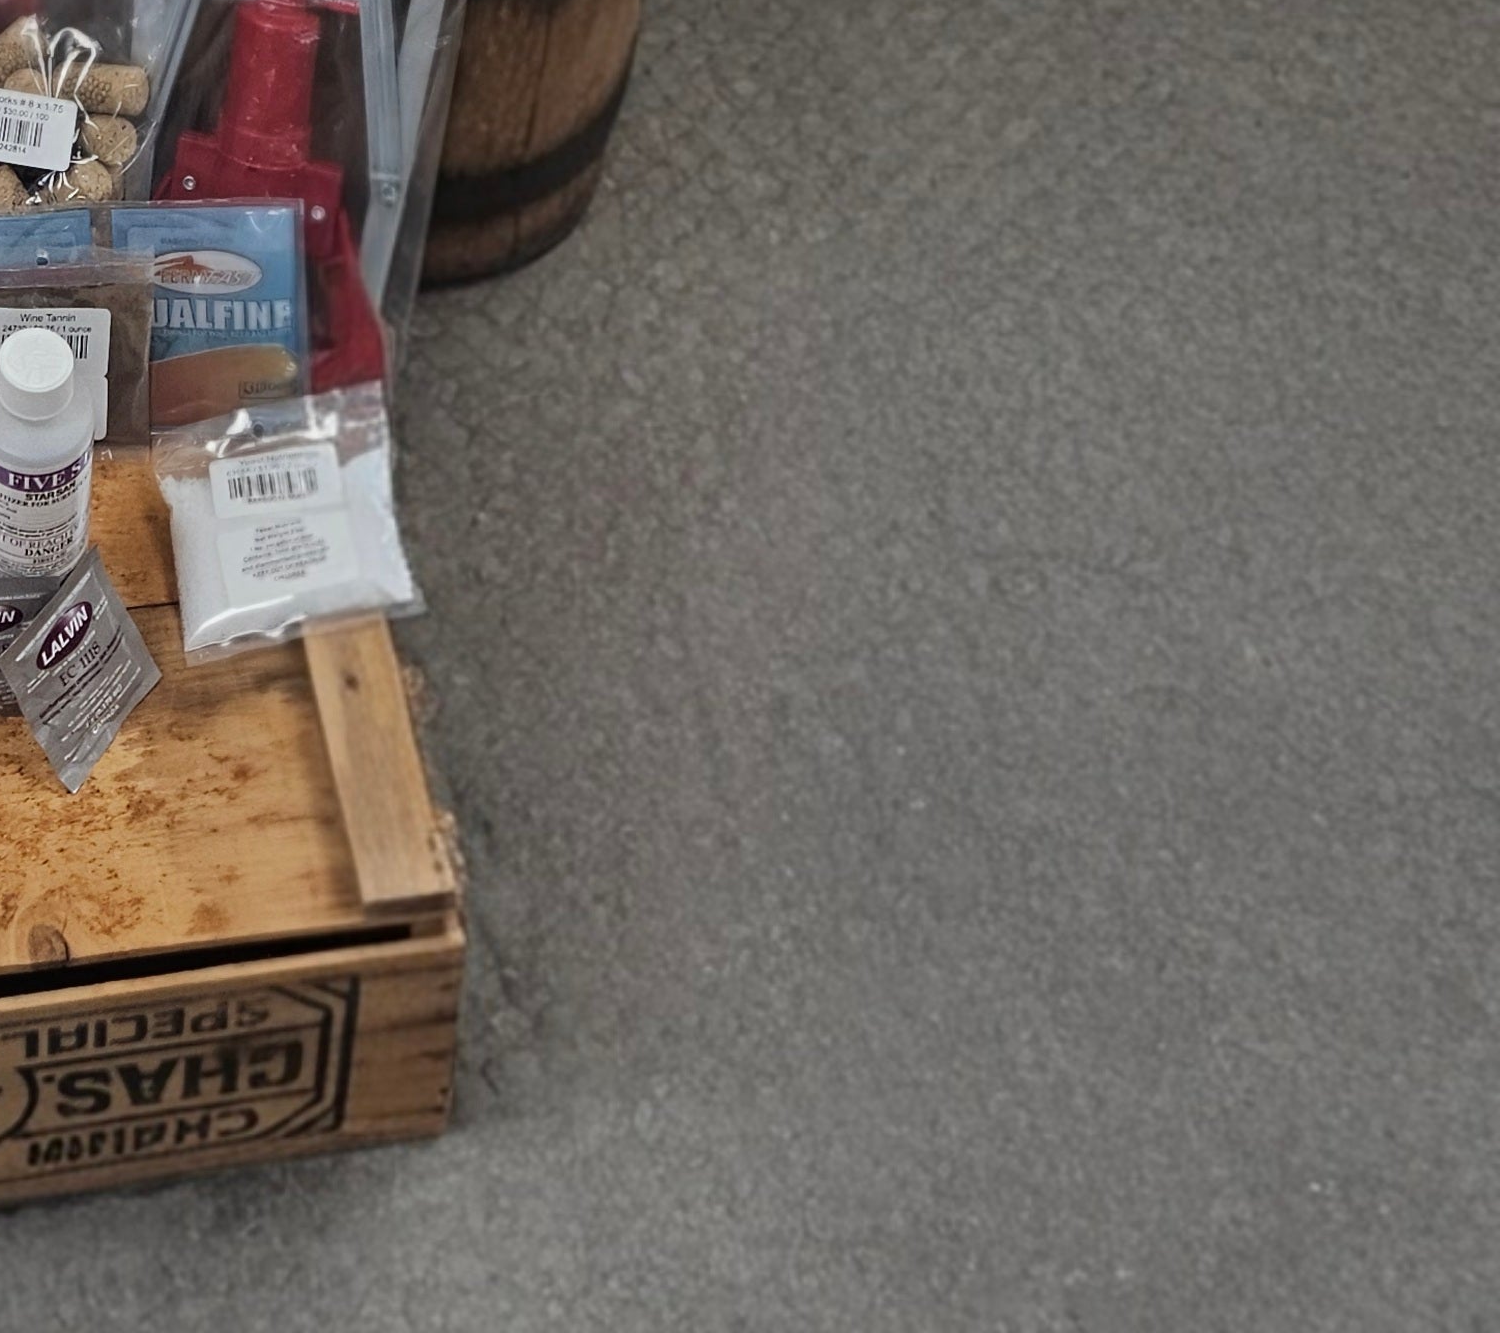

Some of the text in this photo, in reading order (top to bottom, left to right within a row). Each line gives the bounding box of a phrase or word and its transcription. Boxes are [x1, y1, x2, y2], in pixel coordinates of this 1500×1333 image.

[28, 100, 34, 108] 8
[45, 102, 64, 114] 1.75
[20, 314, 76, 322] Wine Tannin
[8, 471, 66, 490] FIVE
[25, 491, 55, 501] STAR
[55, 480, 76, 495] SAN
[24, 535, 74, 557] DANGER
[41, 605, 89, 667] LALVIN
[1, 999, 271, 1059] SPECIAL
